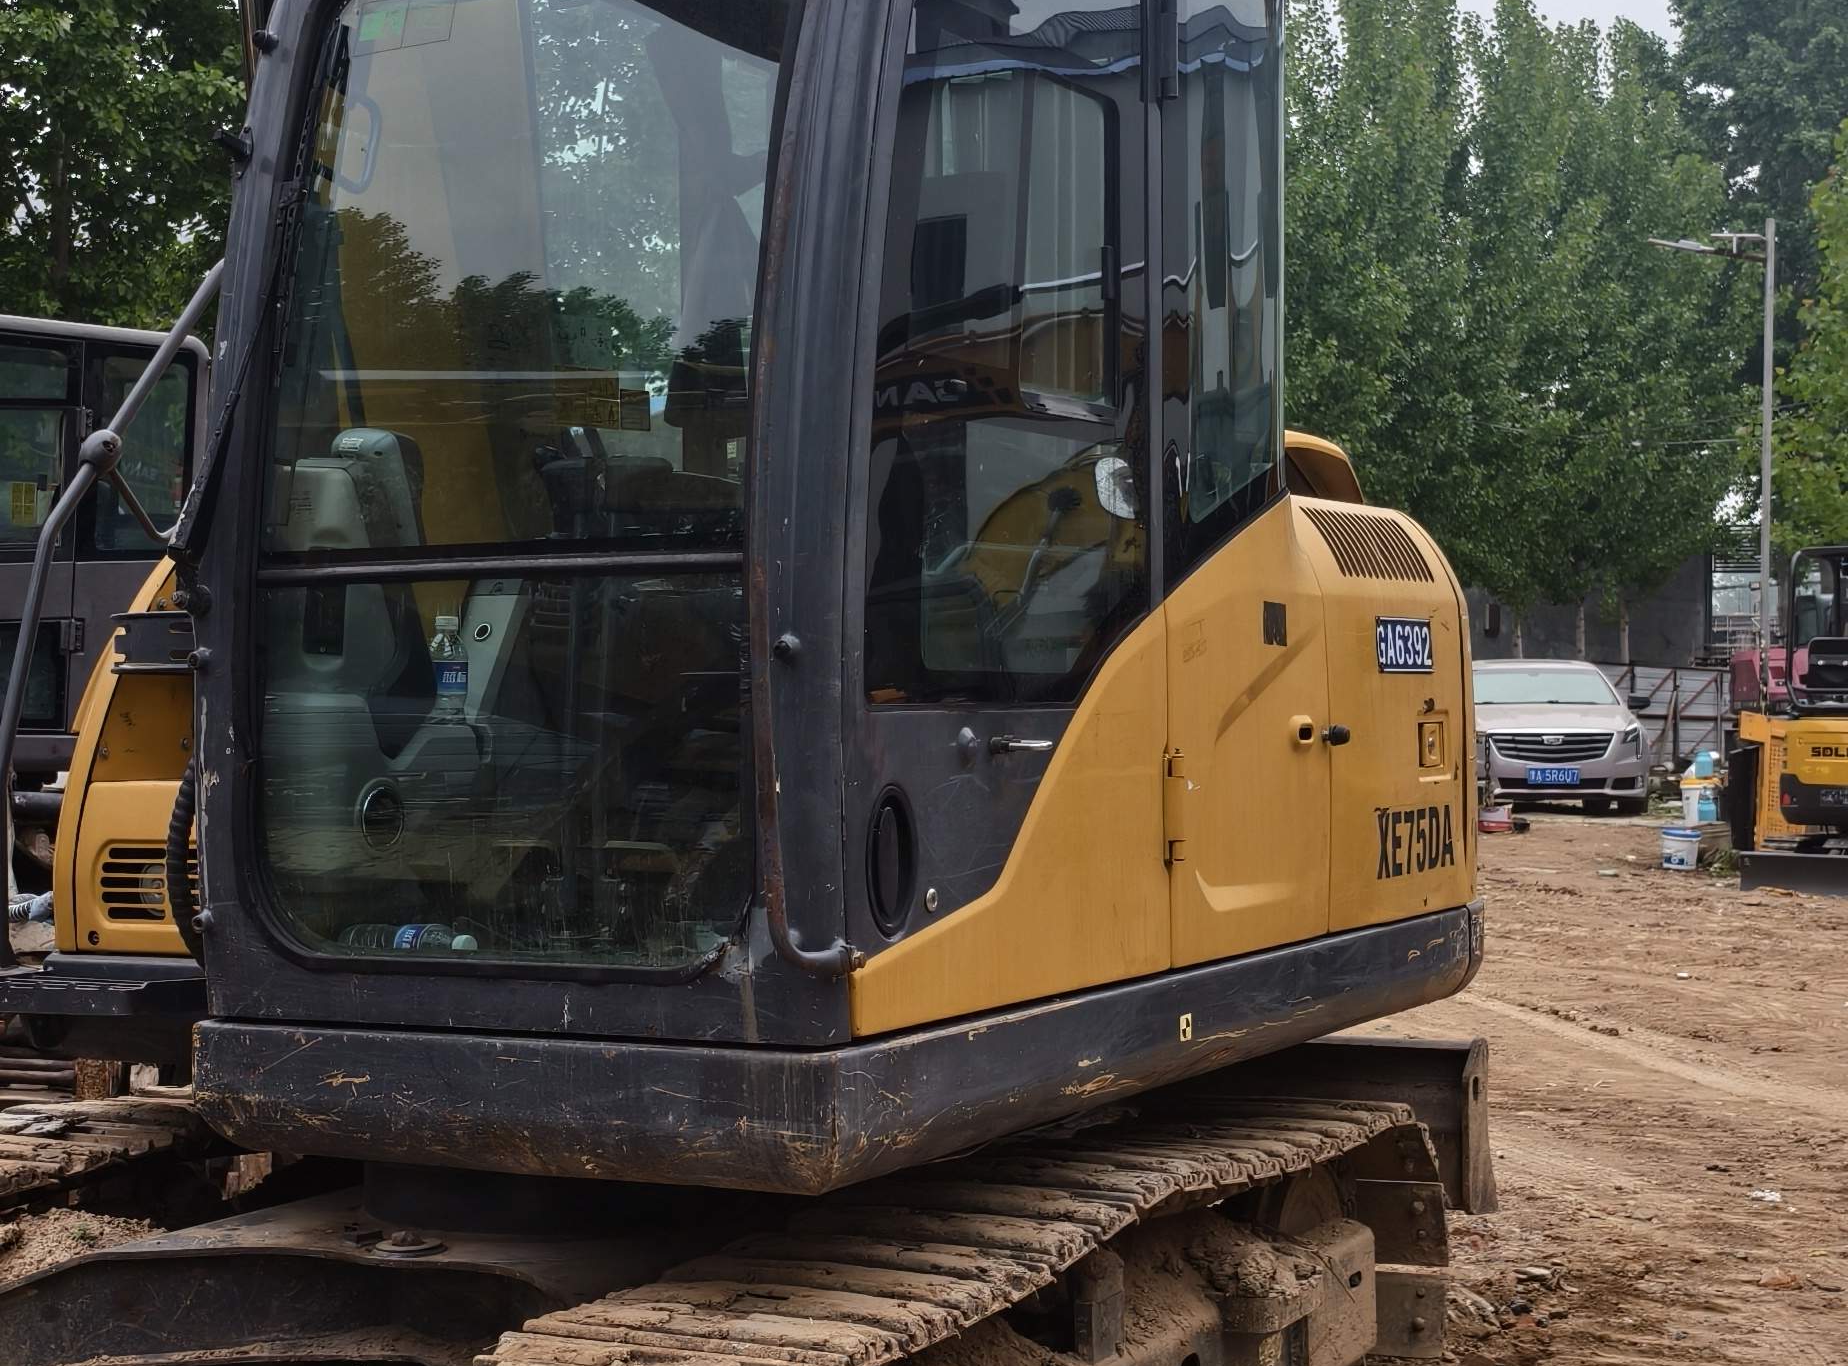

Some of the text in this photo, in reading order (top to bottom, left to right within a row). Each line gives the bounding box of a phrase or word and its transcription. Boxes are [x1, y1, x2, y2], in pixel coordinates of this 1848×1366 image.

[1377, 624, 1432, 666] GA6392
[1811, 746, 1848, 758] SDL
[1376, 804, 1455, 880] XE75DA
